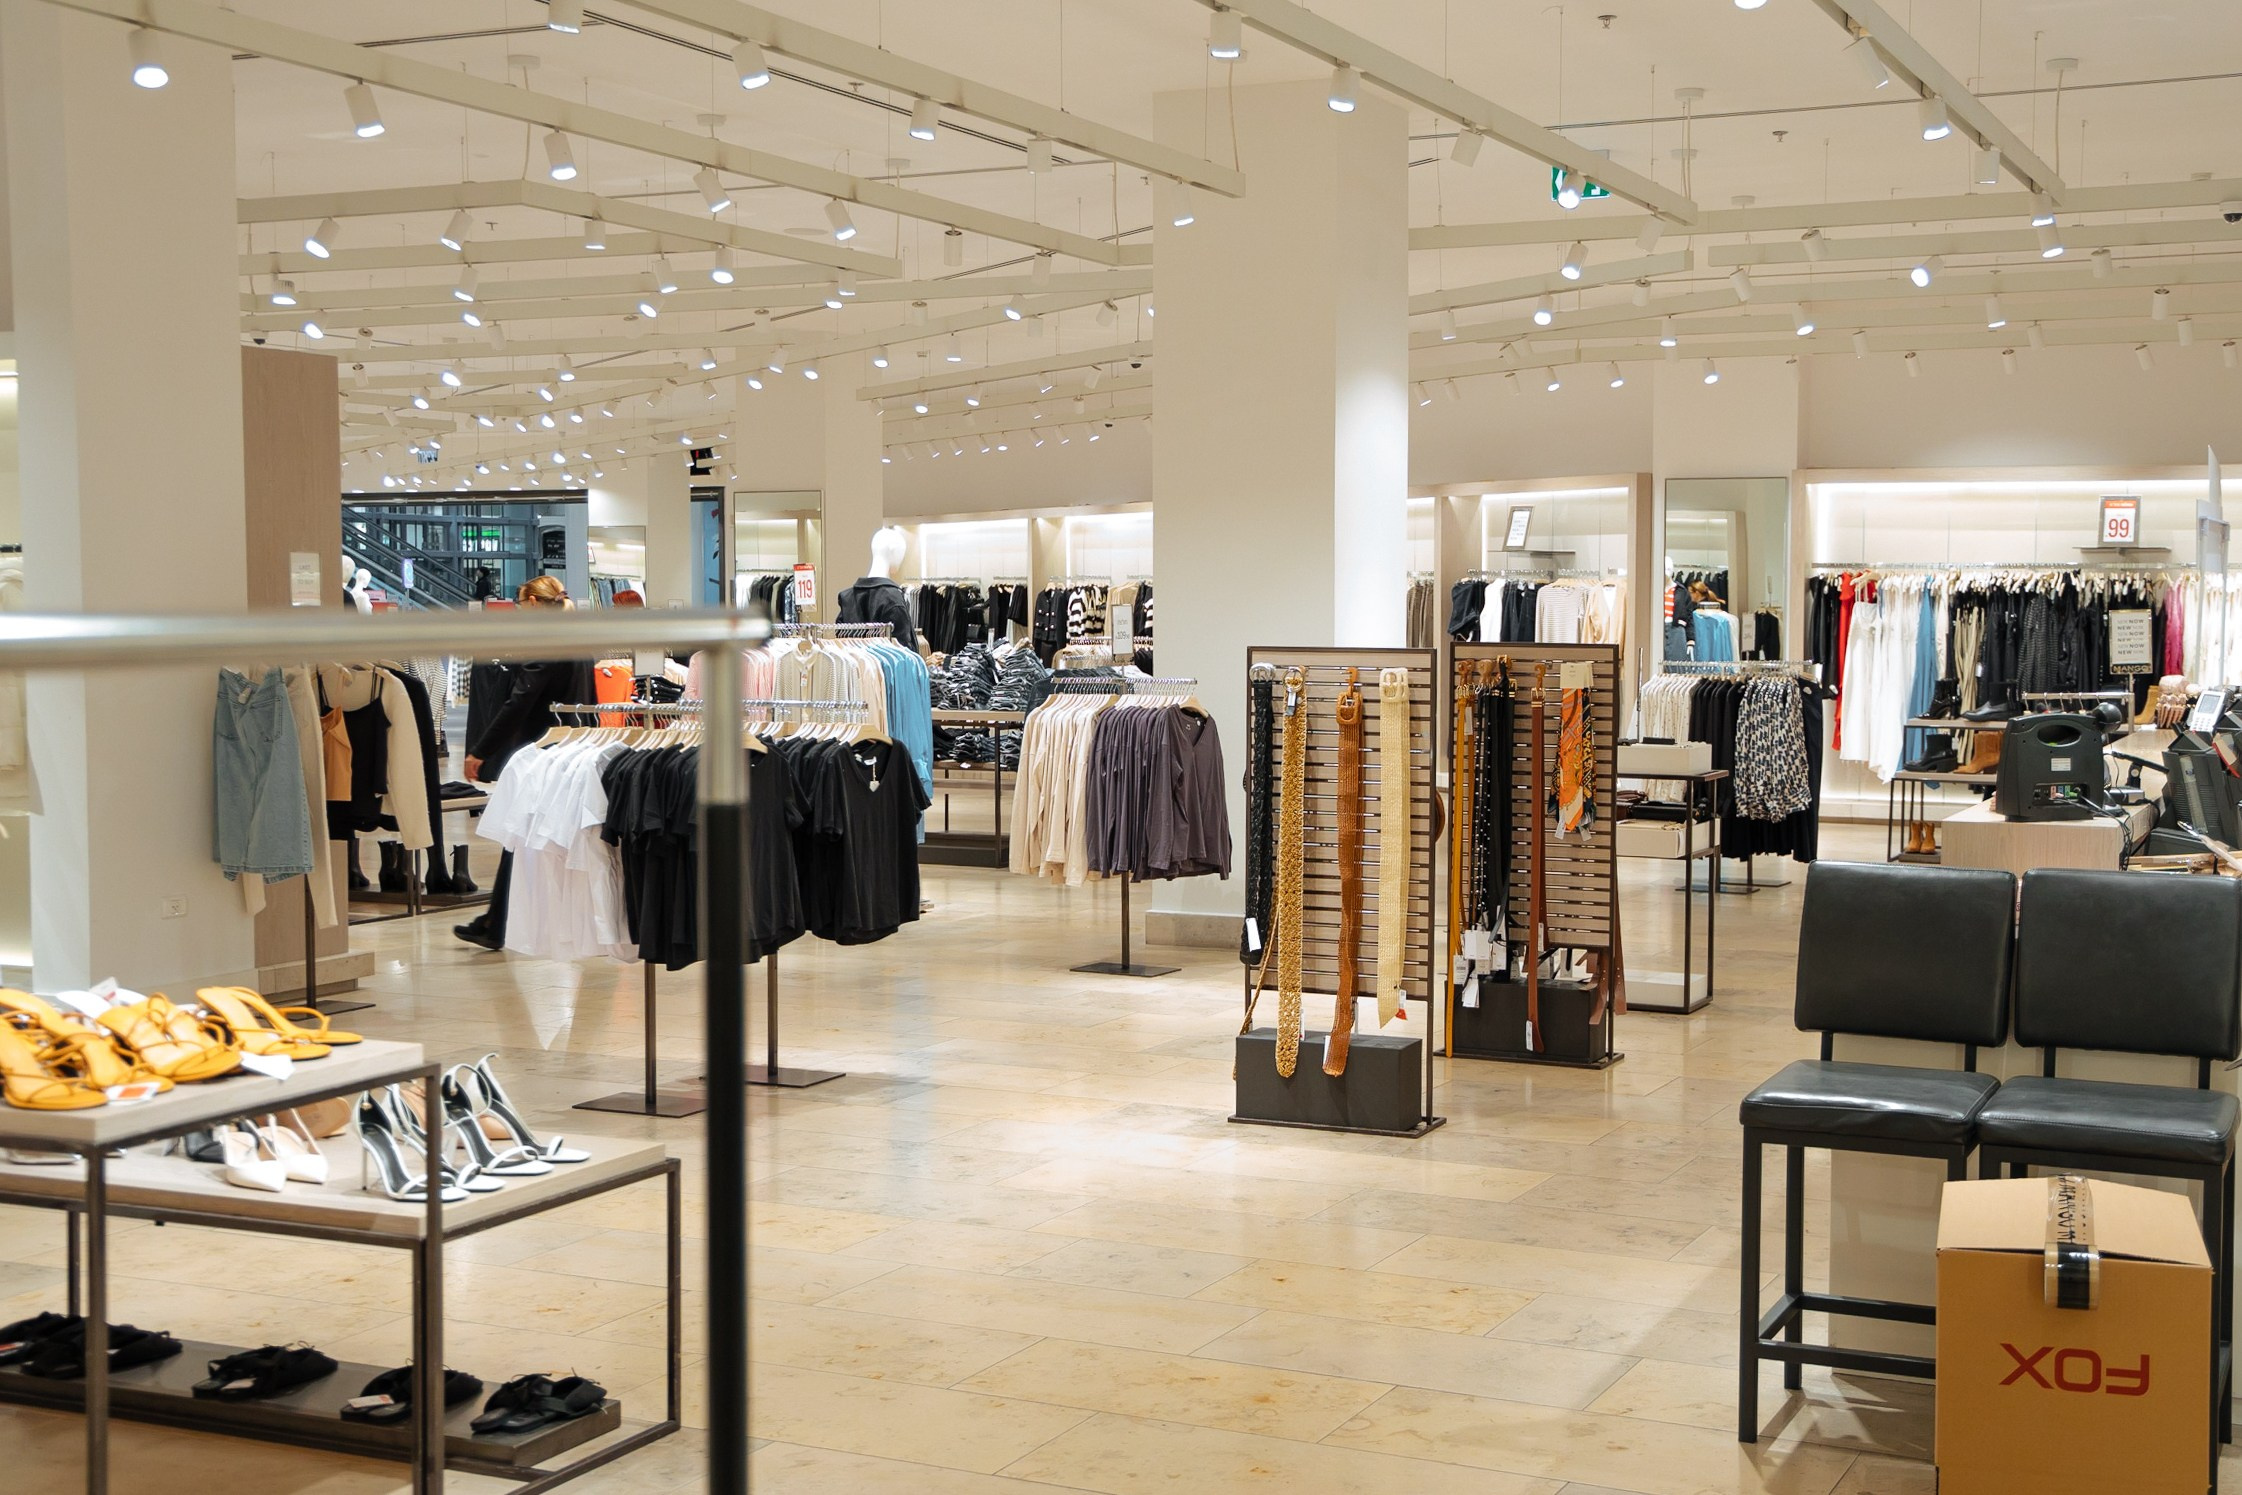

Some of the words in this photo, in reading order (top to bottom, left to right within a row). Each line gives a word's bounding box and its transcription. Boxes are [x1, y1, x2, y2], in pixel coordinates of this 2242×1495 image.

[2108, 518, 2129, 538] 99
[798, 579, 813, 599] 119
[1999, 1343, 2150, 1396] FOX
